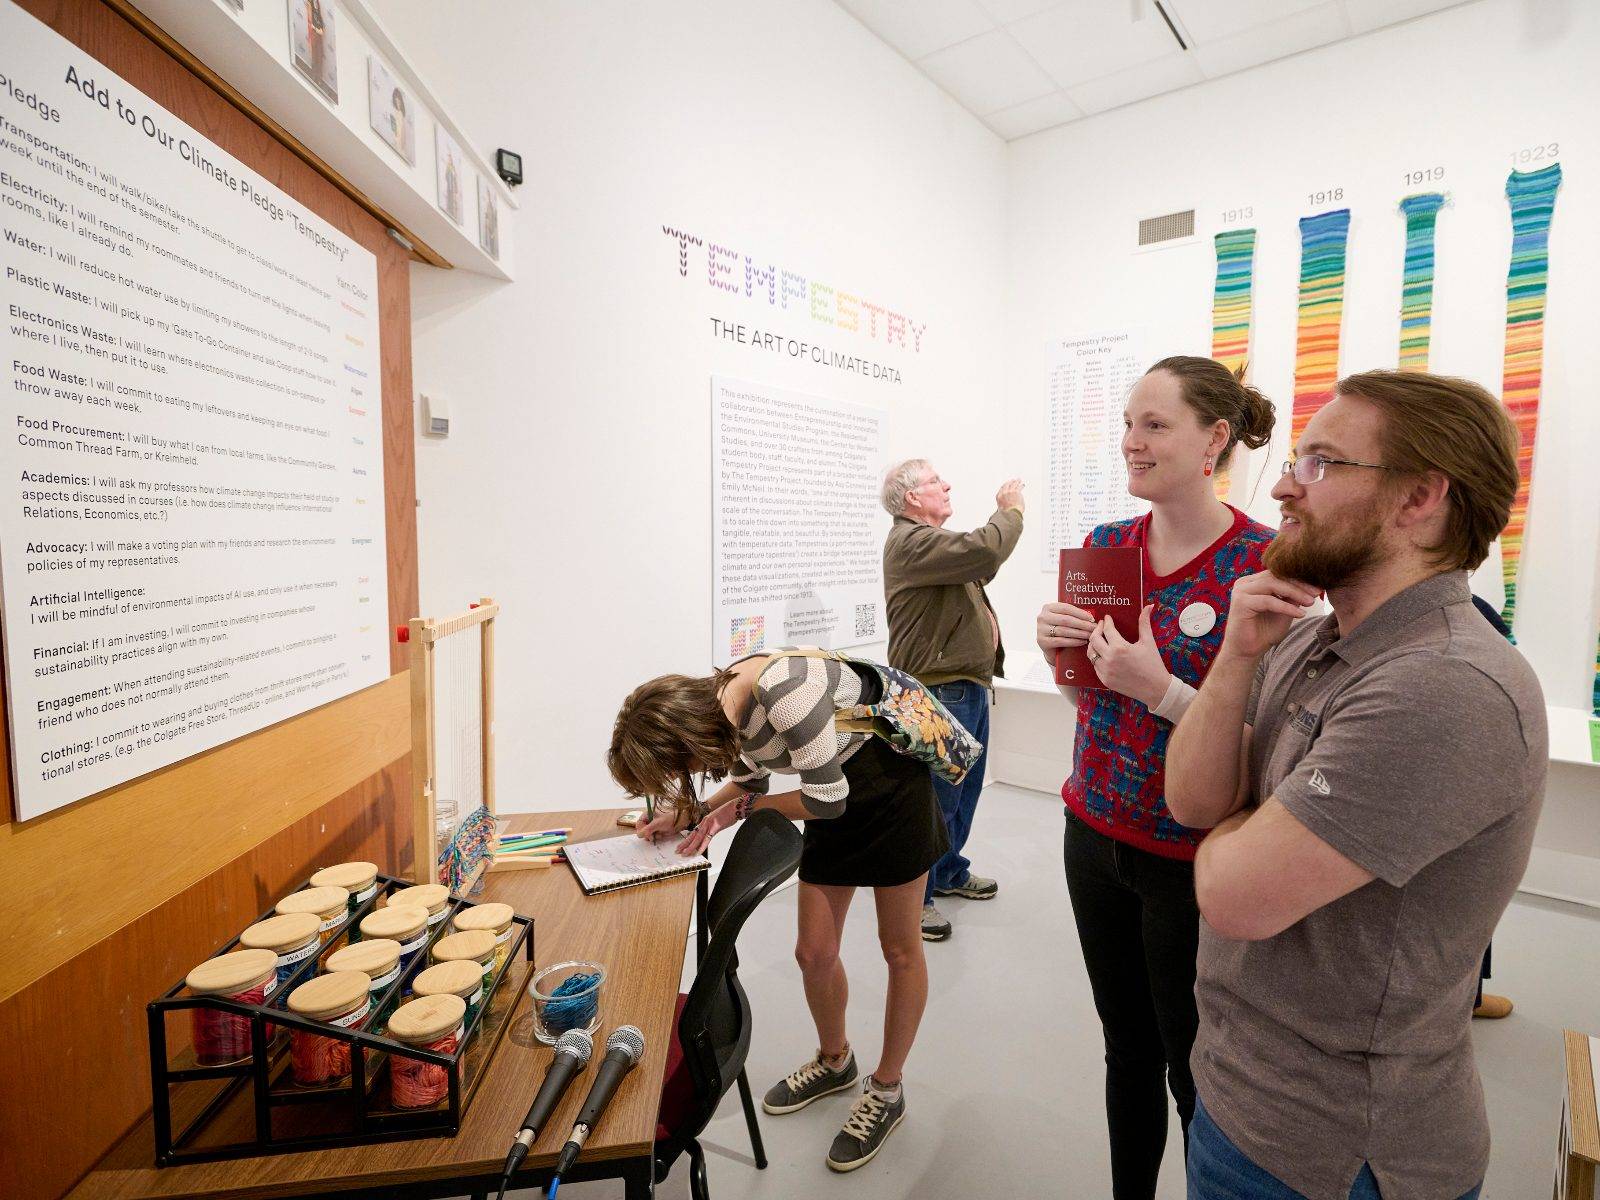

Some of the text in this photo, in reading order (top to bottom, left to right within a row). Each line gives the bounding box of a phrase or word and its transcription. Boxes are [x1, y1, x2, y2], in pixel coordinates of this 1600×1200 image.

[65, 65, 109, 109] Add
[116, 98, 136, 125] to
[142, 115, 174, 150] Our
[180, 140, 237, 191] Climate
[241, 180, 284, 221] Pledge
[1508, 142, 1560, 166] 1923
[0, 138, 180, 235] week until the end the semester.
[1404, 166, 1445, 186] 1919
[100, 172, 118, 187] will
[120, 182, 186, 222] walk/bike/take
[1306, 188, 1344, 206] 1918
[0, 172, 198, 272] Electricity: will remind my roommates
[2, 194, 134, 258] rooms, like already do.
[1221, 206, 1254, 224] 1913
[4, 228, 162, 298] Water: will reduce hot water
[7, 266, 140, 322] Plastic Waste: will pick
[336, 274, 352, 290] Yarn
[662, 225, 927, 353] TEMPESTRY
[10, 304, 193, 366] Electronics Waste: will learn where
[10, 325, 128, 364] where live, then put
[1062, 334, 1128, 349] Tempestry Project
[710, 317, 902, 385] THE ART OF CLIMATE DATA
[13, 360, 190, 410] Food Waste: will commit eating
[14, 380, 142, 414] throw away each week.
[720, 388, 735, 398] This
[17, 416, 190, 450] Food Procurement: will buy what
[18, 434, 73, 452] Common
[76, 440, 112, 456] Thread
[116, 446, 142, 460] Farm,
[722, 458, 758, 470] Tempestry
[732, 472, 744, 480] The
[21, 470, 198, 494] Academics: will ask my professors
[722, 482, 740, 492] Emily
[22, 490, 174, 506] aspects discussed courses
[722, 506, 740, 514] scale
[23, 506, 142, 522] Relations, Economics,
[26, 540, 179, 555] Advocacy: will make voting
[722, 540, 738, 548] with
[27, 554, 180, 574] policies of my representatives.
[722, 563, 746, 572] climate
[1065, 570, 1088, 582] Arts,
[30, 588, 146, 607] Artificial Intelligence:
[722, 596, 746, 606] climate
[1065, 582, 1116, 596] Creativity,
[1072, 594, 1131, 606] Innovation
[38, 593, 224, 623] will be mindful of environmental impacts
[33, 620, 220, 660] Financial: am investing, commit
[34, 635, 198, 678] sustainability practices align with
[37, 650, 260, 712] Engagement: When attending sustainability-related
[1065, 669, 1075, 680] C
[38, 674, 209, 730] friend who does not normally attend
[40, 698, 228, 764] Clothing: commit wearing buying
[42, 718, 204, 782] tional stores. Colgate Free
